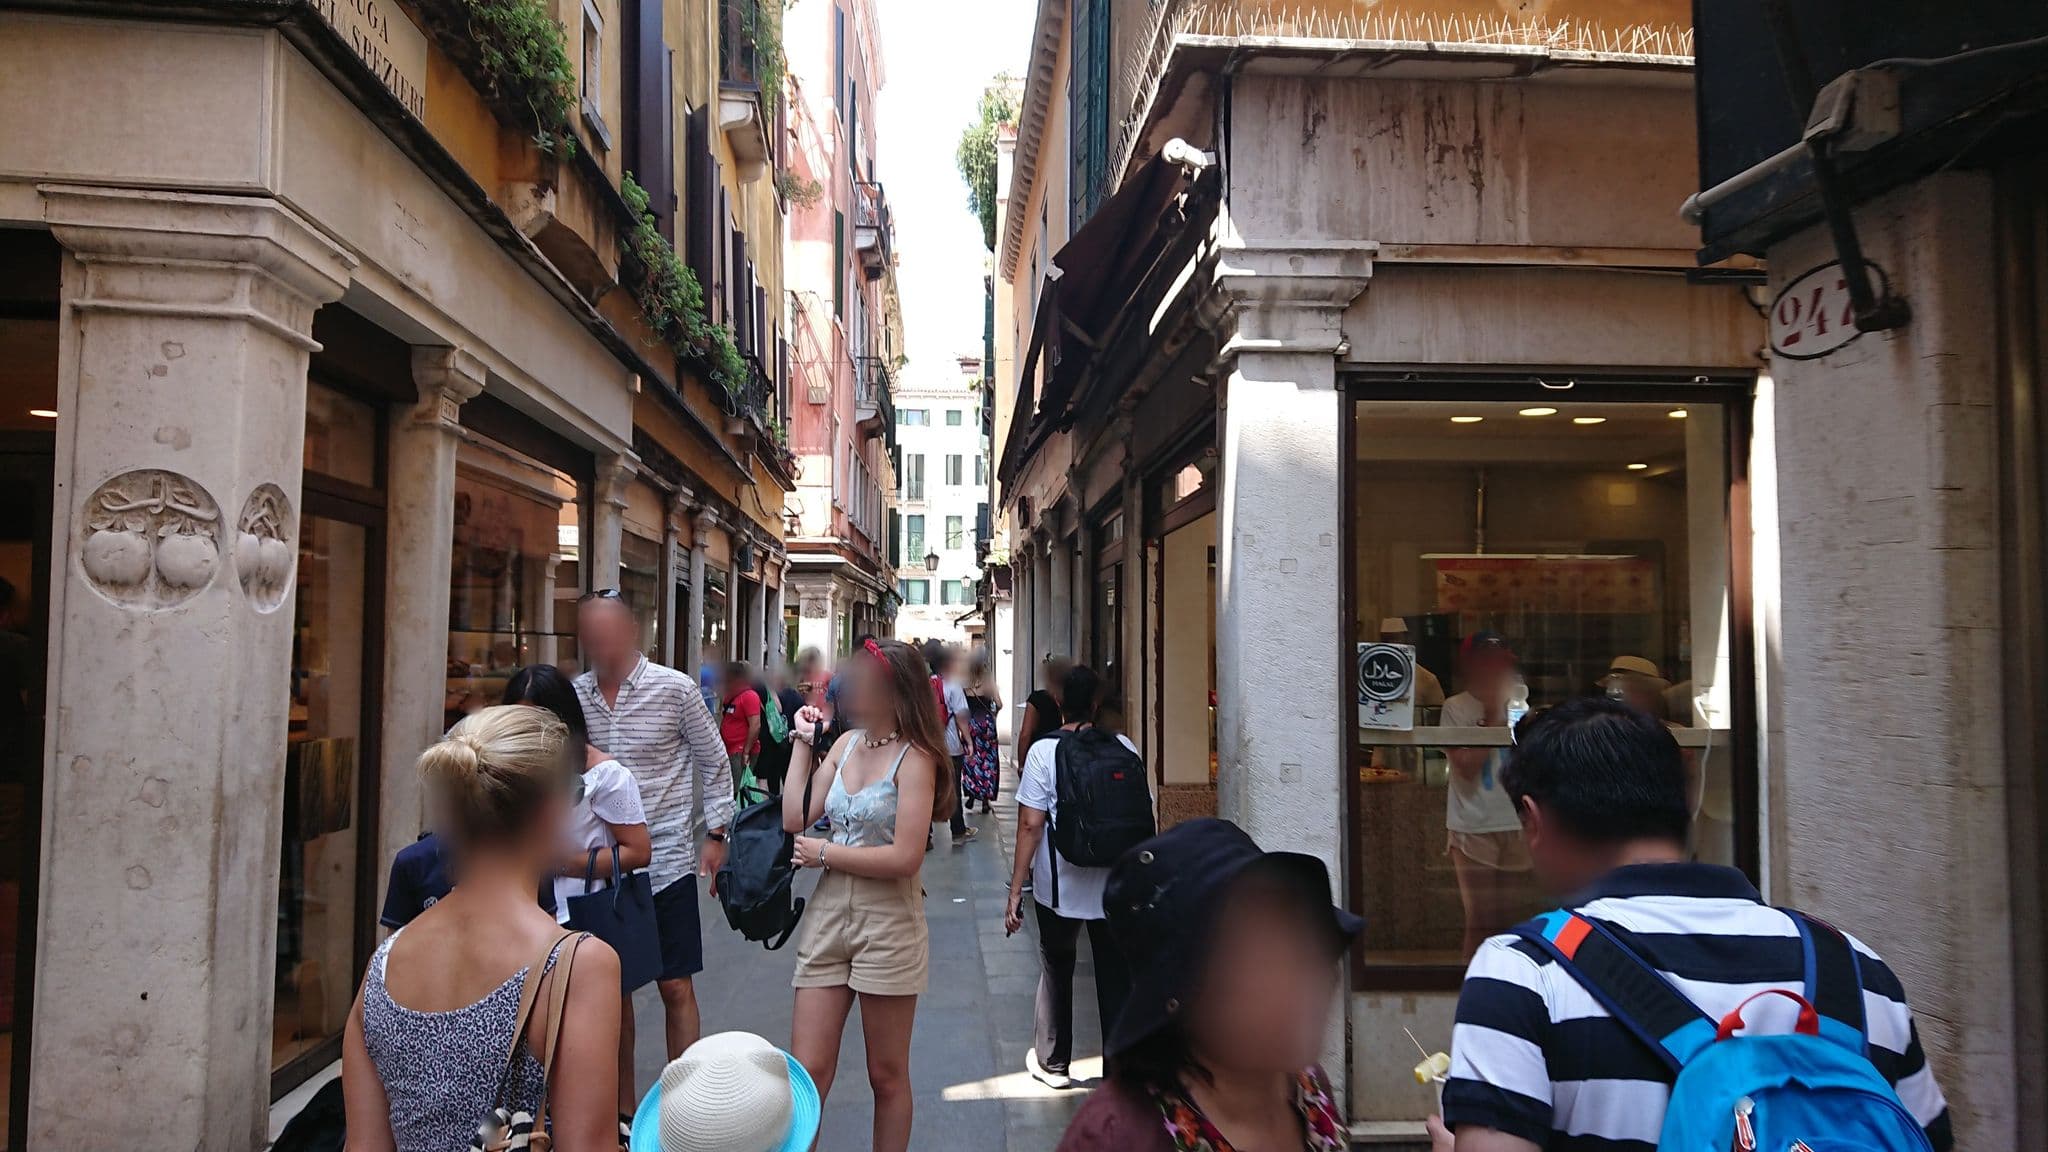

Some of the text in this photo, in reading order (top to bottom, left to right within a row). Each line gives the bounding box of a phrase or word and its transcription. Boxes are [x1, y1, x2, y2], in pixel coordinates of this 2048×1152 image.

[350, 0, 389, 44] UGA
[351, 24, 425, 122] SPEZIERI
[1364, 660, 1403, 680] حلال
